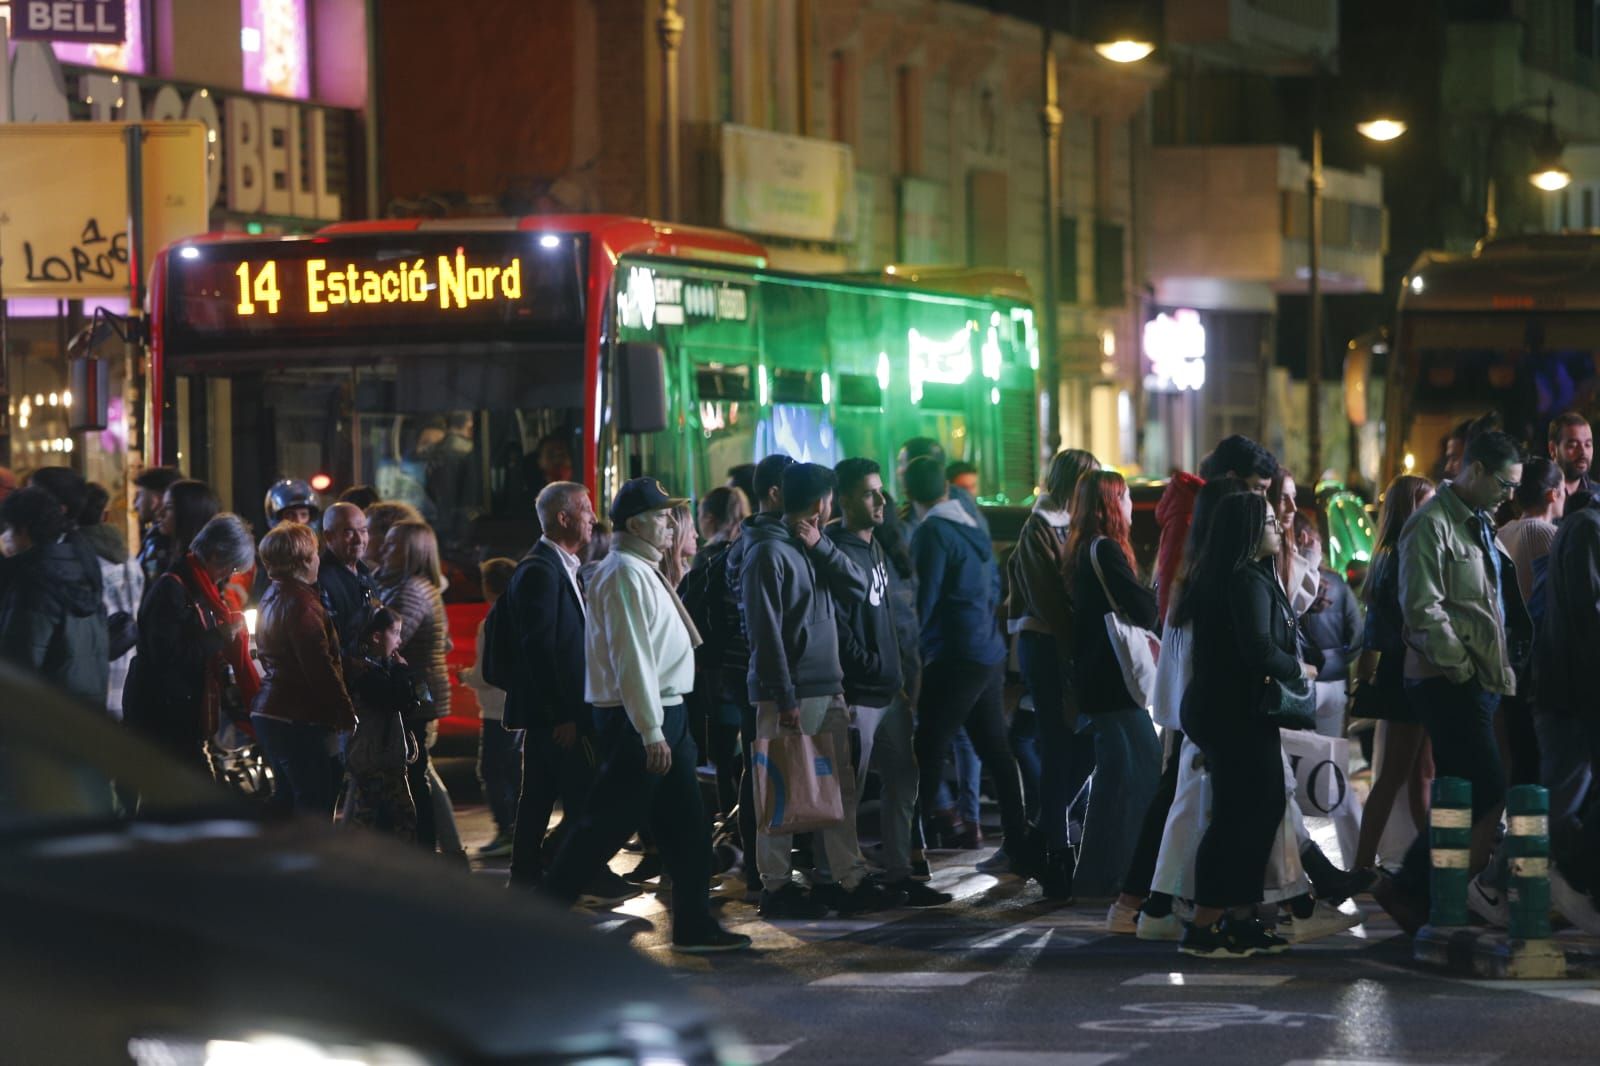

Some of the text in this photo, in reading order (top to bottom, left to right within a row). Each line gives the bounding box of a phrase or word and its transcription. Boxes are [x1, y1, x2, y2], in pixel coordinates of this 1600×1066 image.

[28, 1, 117, 32] BELL
[226, 95, 341, 220] BELL
[235, 254, 521, 315] 14 Estació Nord
